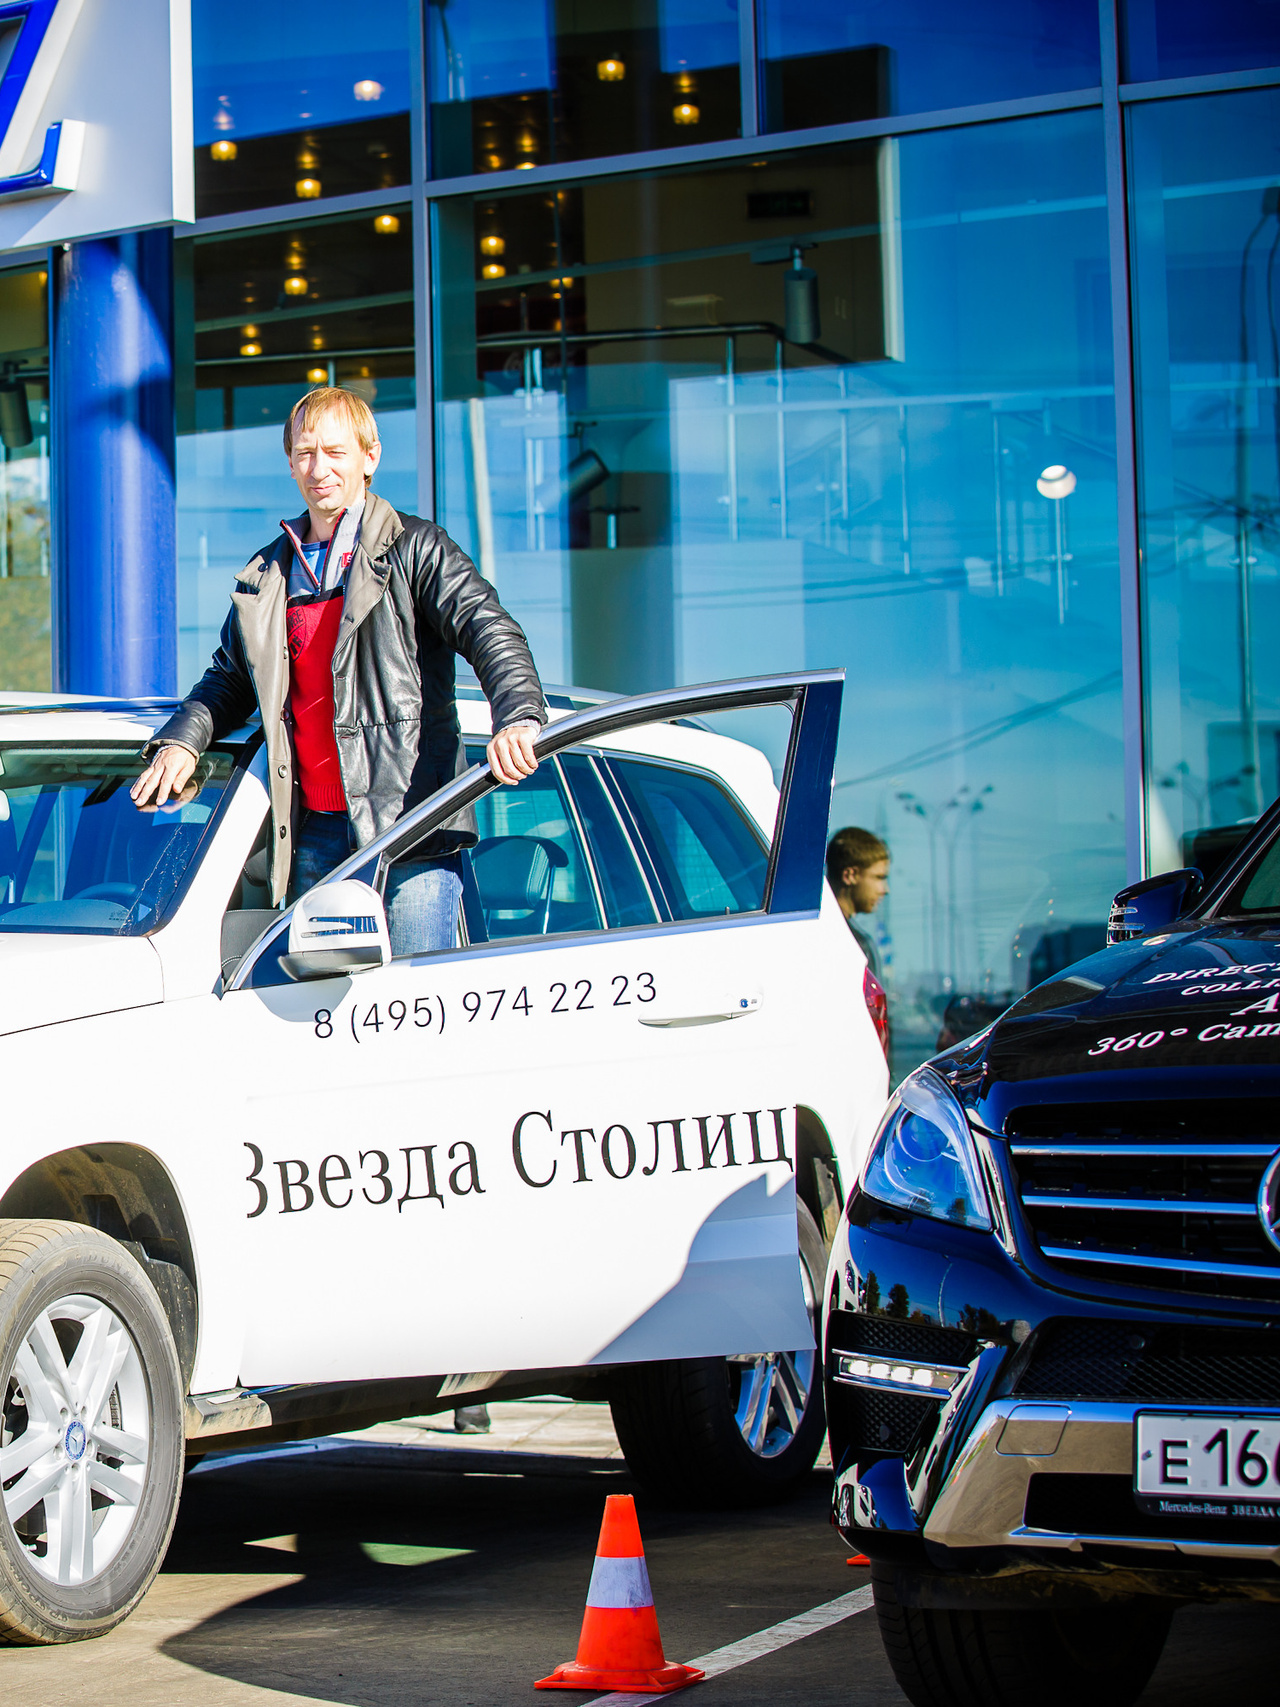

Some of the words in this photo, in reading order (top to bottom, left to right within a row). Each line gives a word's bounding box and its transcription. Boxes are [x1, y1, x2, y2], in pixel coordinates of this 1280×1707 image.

[313, 1007, 335, 1040] 8
[350, 995, 448, 1044] (495)
[462, 985, 535, 1024] 974
[549, 979, 595, 1013] 22
[611, 971, 659, 1009] 23
[1158, 1500, 1228, 1516] Mercedes-Benz
